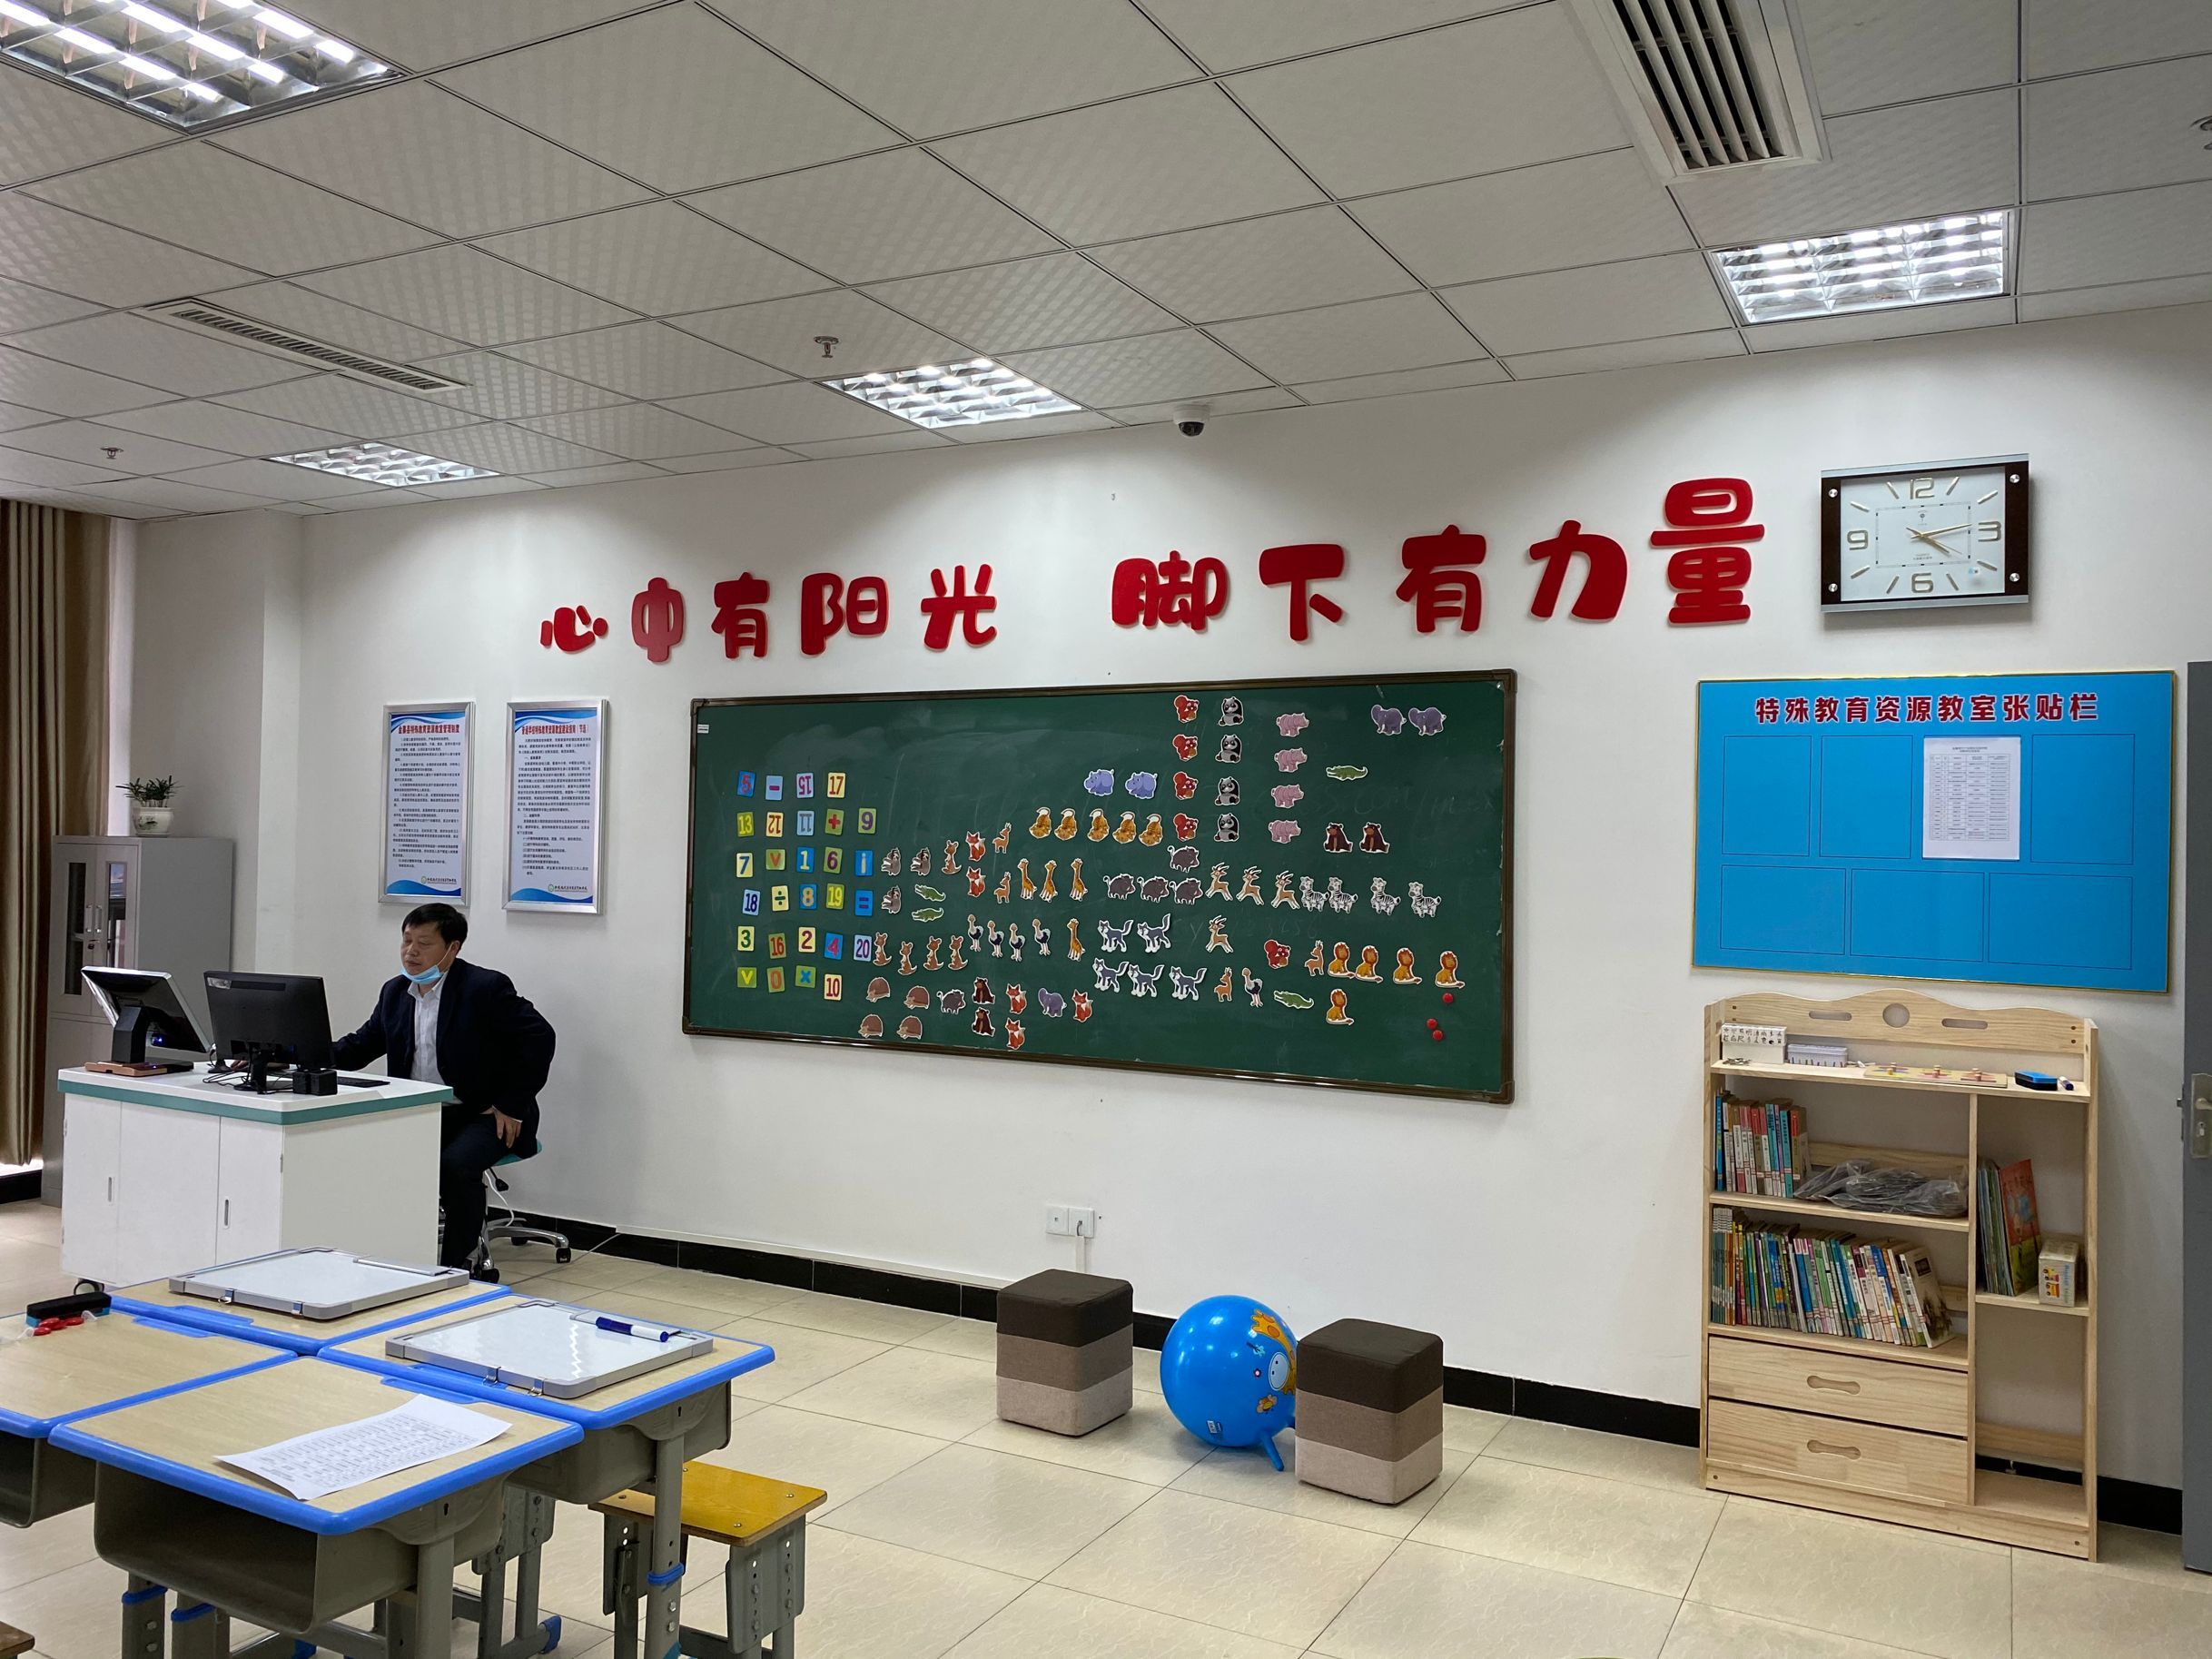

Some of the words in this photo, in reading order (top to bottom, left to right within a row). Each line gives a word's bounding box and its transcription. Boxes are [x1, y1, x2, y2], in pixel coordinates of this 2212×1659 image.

[1910, 477, 1935, 500] 12
[1846, 529, 1869, 551] 9
[1978, 520, 2002, 543] 3
[539, 563, 998, 663] 心中有阳光
[1111, 477, 1765, 642] 脚下有力量
[1911, 572, 1934, 594] 6
[1754, 693, 2098, 724] 特殊教育资源教室张贴栏
[741, 775, 751, 794] 5
[799, 775, 812, 795] 15
[829, 775, 844, 795] 17
[739, 815, 753, 834] 13
[768, 815, 782, 834] 12
[861, 811, 874, 831] 9
[739, 856, 750, 875] 7
[800, 850, 810, 871] 1
[827, 851, 838, 870] 6
[745, 893, 758, 913] 18
[802, 887, 815, 907] 8
[828, 885, 843, 907] 19
[740, 929, 751, 948] 3
[770, 936, 785, 956] 16
[801, 930, 813, 950] 2
[827, 937, 840, 956] 4
[855, 938, 870, 959] 20
[826, 978, 841, 997] 10
